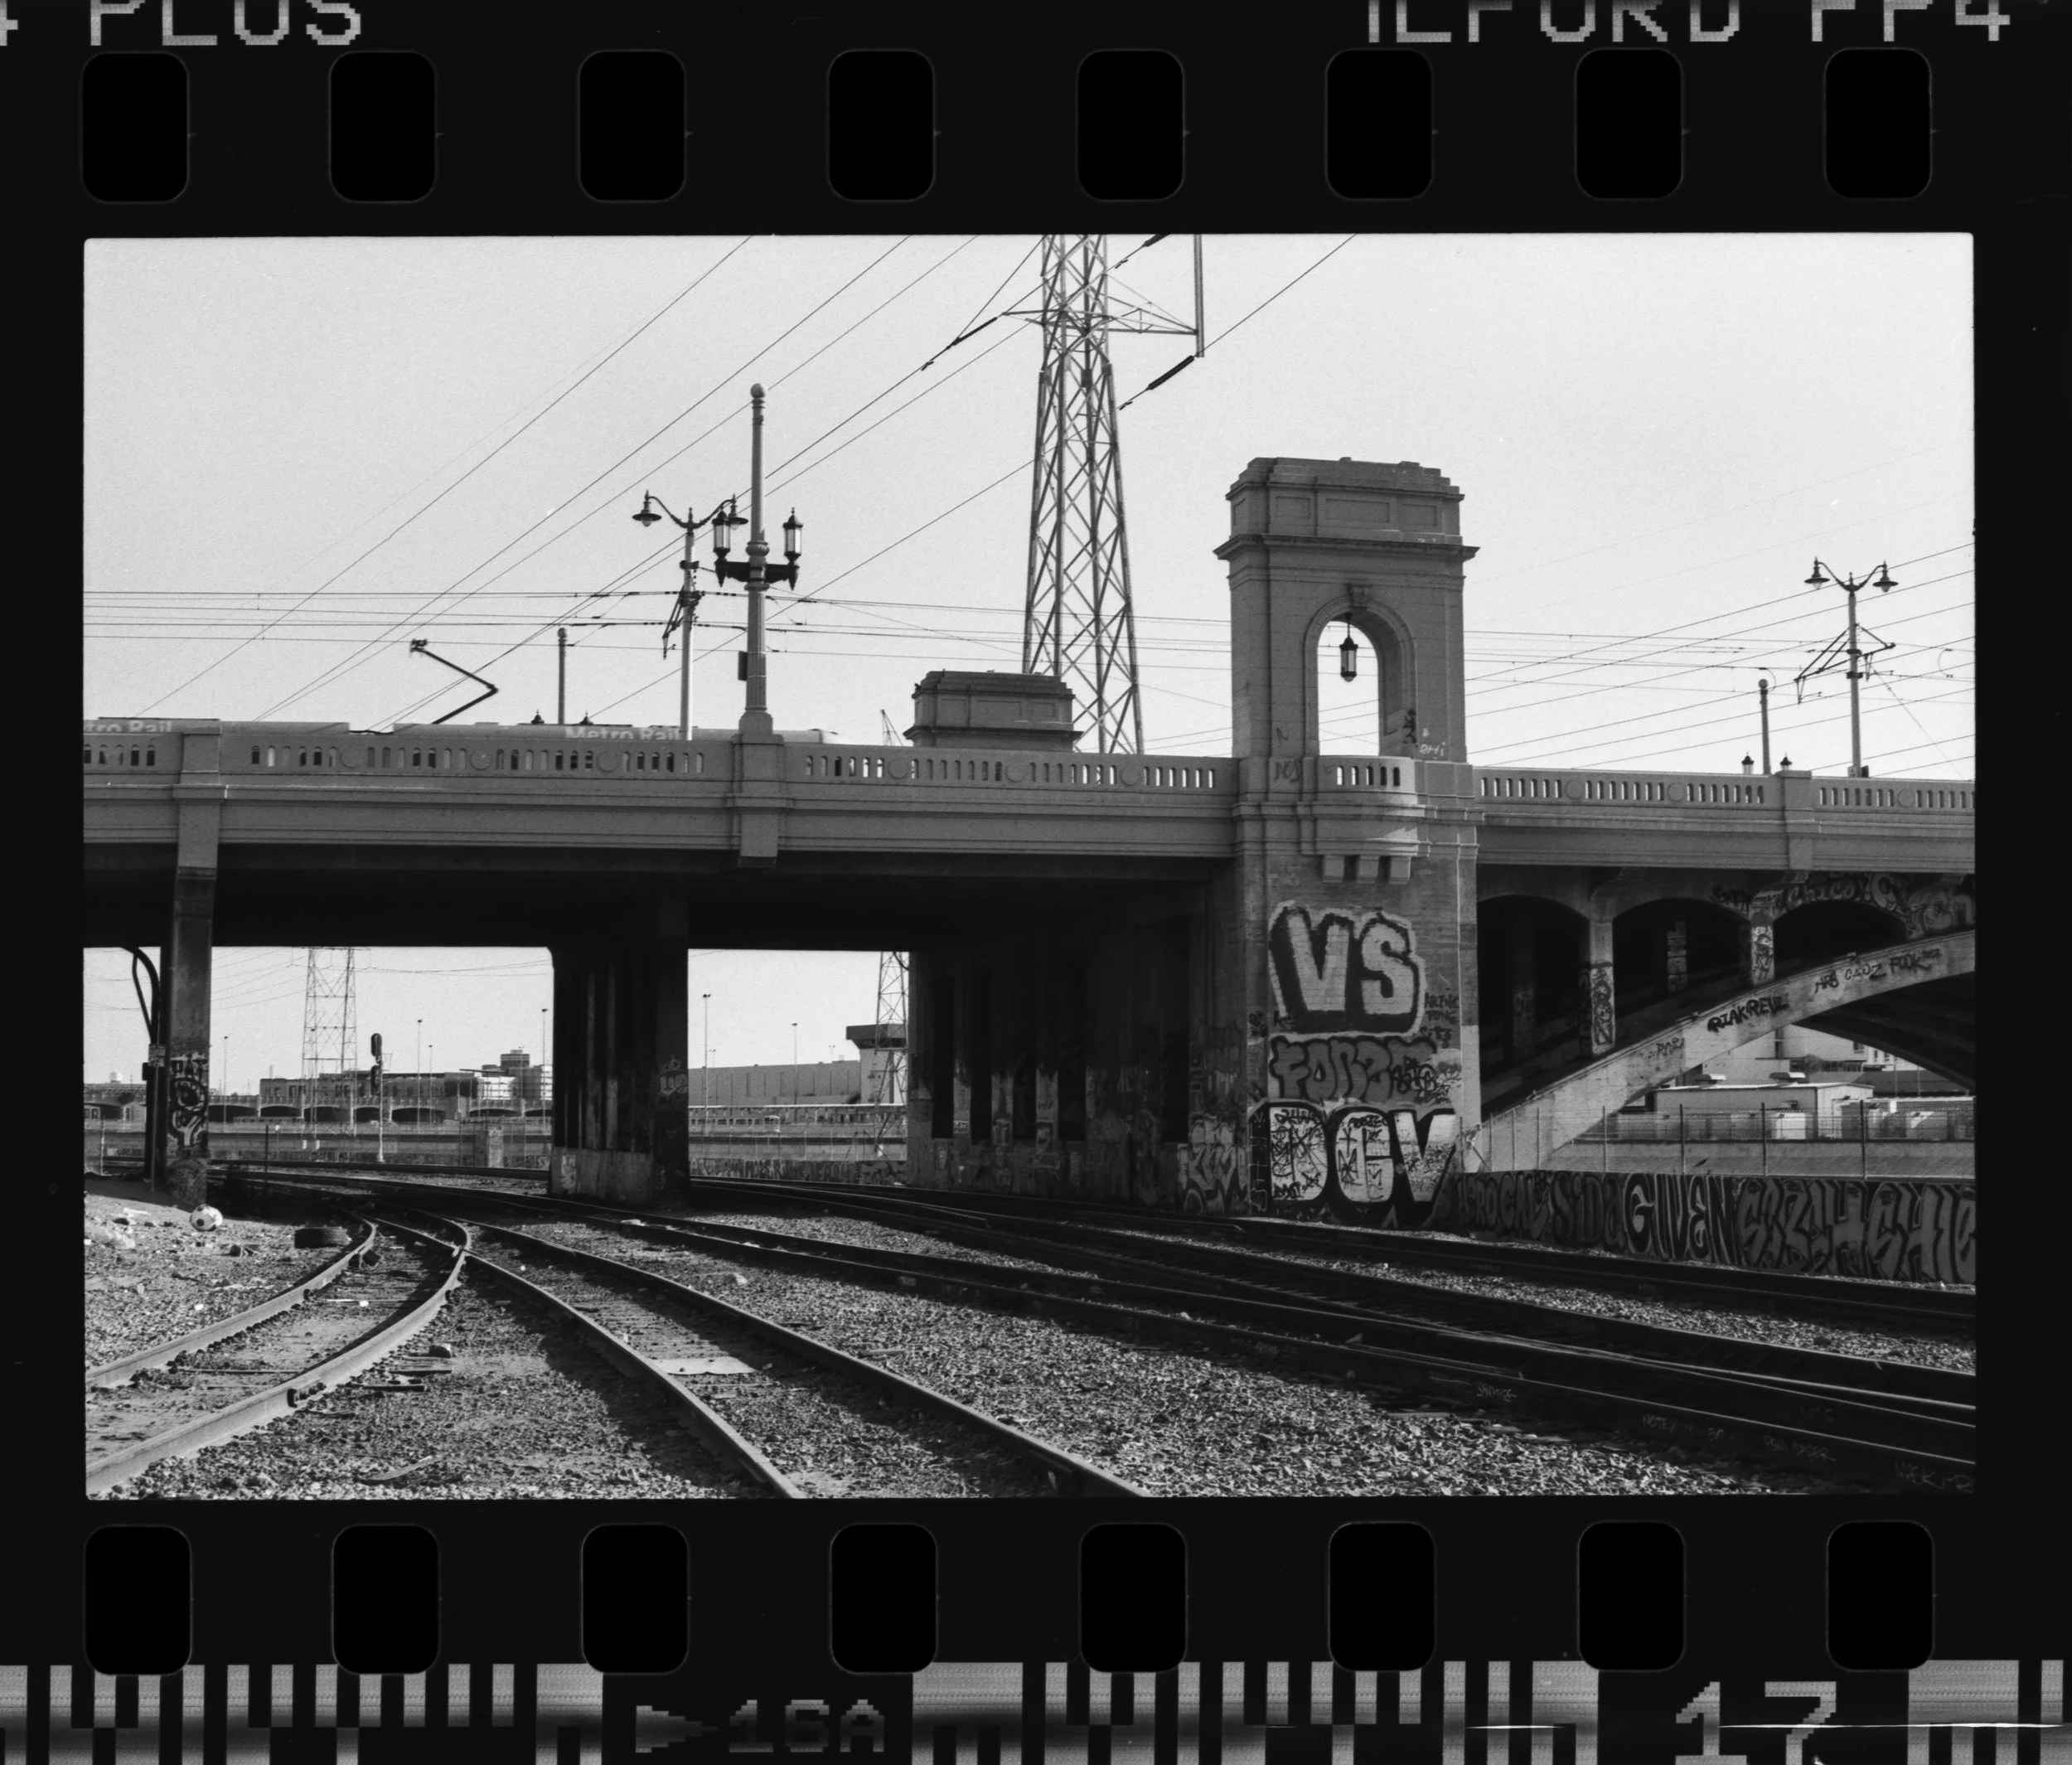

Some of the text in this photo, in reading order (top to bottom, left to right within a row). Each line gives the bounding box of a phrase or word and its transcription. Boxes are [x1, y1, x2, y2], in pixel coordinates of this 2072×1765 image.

[90, 0, 361, 46] PLUS
[1368, 0, 2010, 43] ILFORD FP4
[128, 720, 172, 733] Rail
[564, 725, 634, 739] Metro
[1269, 902, 1425, 1035] VS
[729, 1700, 884, 1753] 16A
[1675, 1681, 1837, 1765] 17
